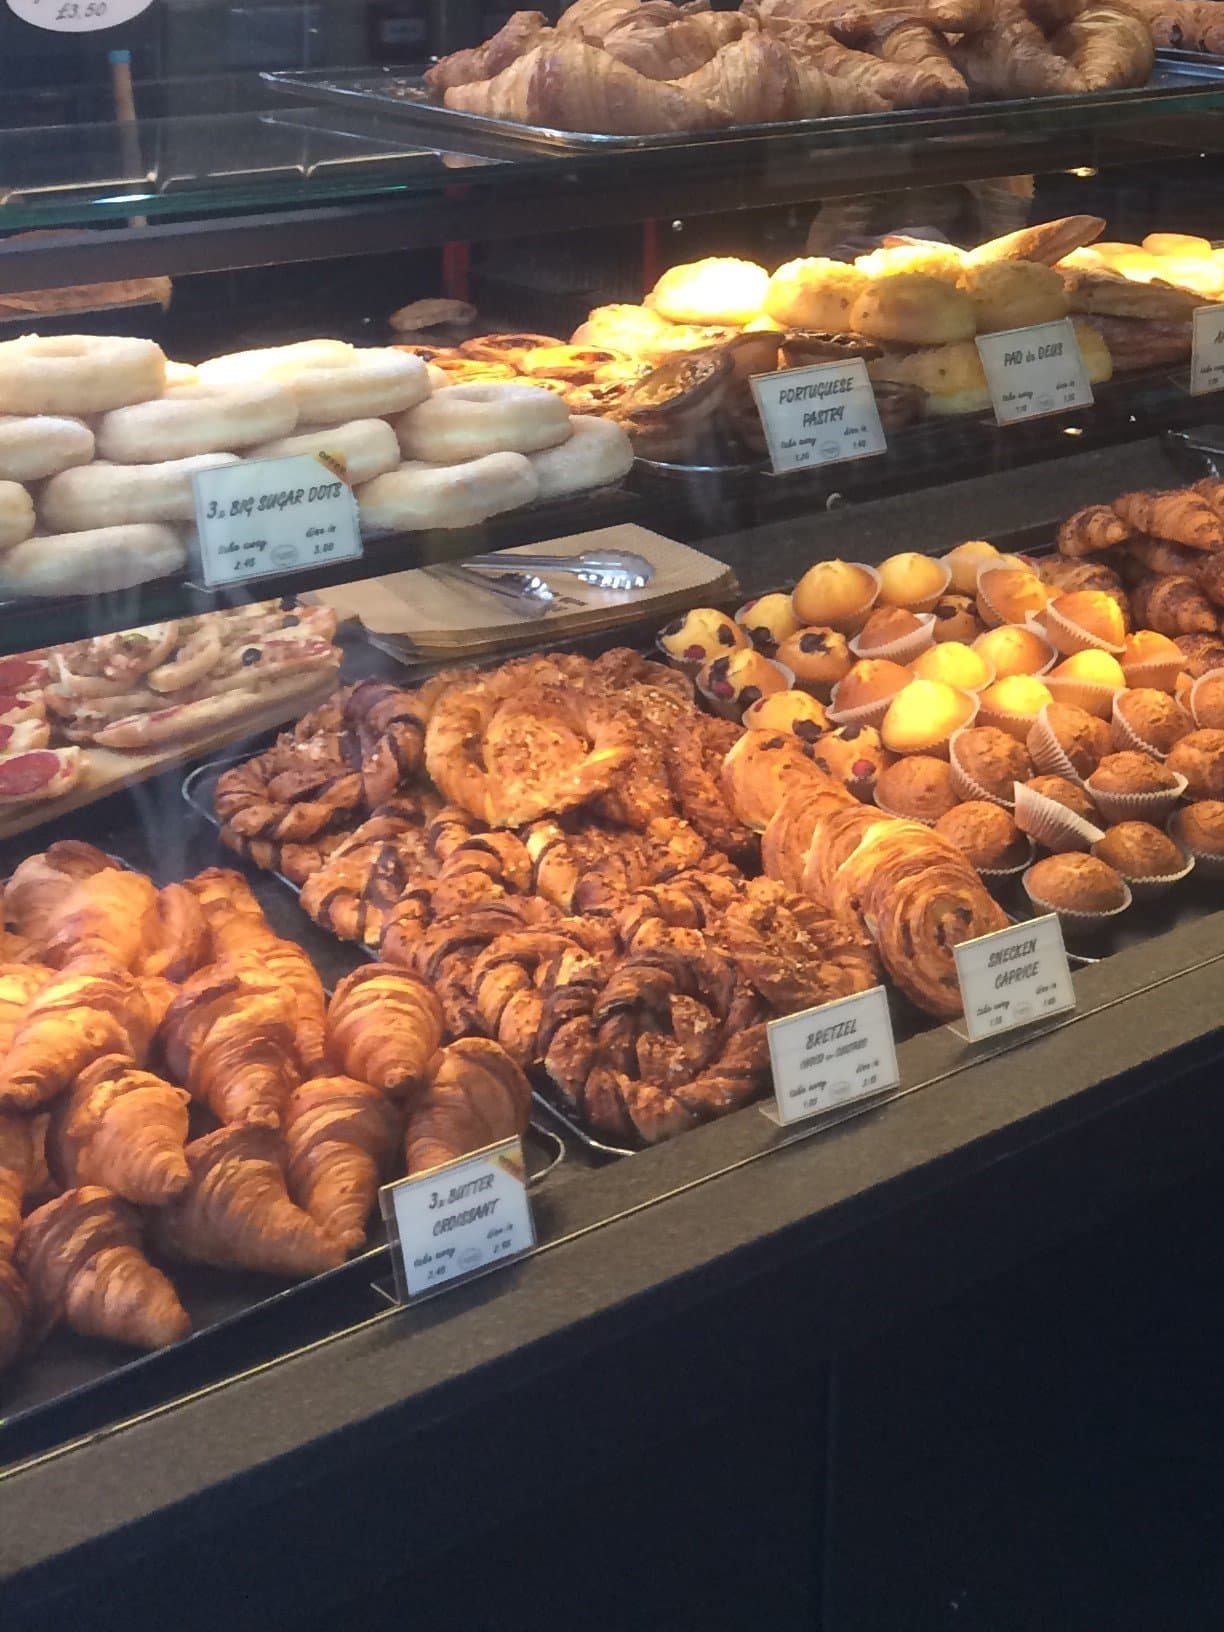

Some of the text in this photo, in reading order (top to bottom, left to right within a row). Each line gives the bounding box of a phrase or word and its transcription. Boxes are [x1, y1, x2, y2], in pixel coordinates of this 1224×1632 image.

[56, 2, 108, 20] £3.50
[779, 377, 854, 404] PORTUGUESE
[802, 406, 845, 427] PASTRY
[229, 482, 342, 517] BIG SUGAR DOTS
[988, 939, 1037, 968] SNECKEN
[995, 961, 1039, 989] CAPRICE
[806, 1018, 857, 1050] BRETZEL
[447, 1174, 494, 1204] BUTTER
[432, 1198, 500, 1237] CROISSANT
